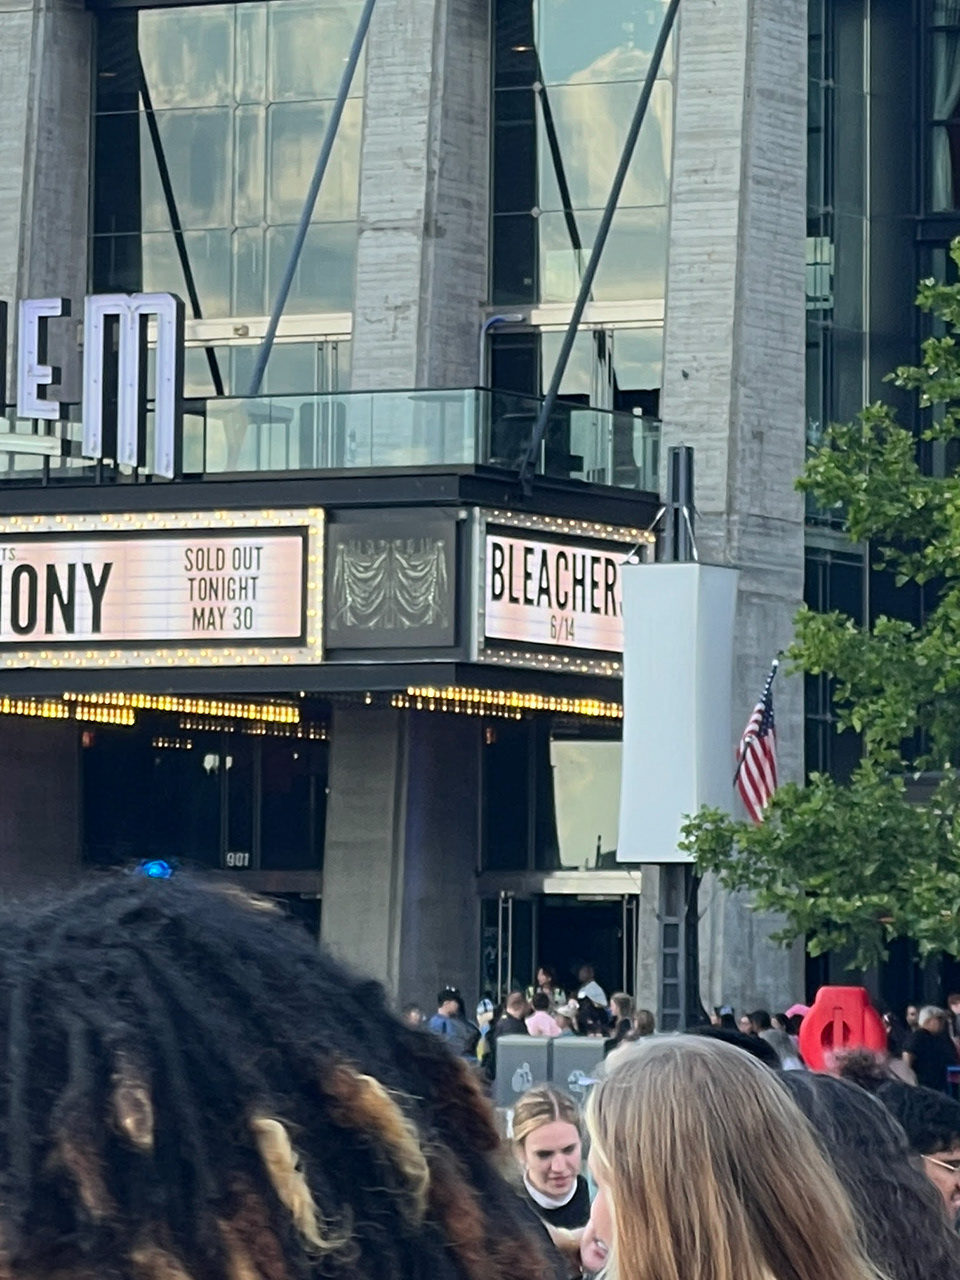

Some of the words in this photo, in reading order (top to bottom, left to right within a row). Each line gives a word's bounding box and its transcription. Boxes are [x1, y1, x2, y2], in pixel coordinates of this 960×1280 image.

[184, 547, 225, 571] SOLD
[232, 546, 263, 570] OUT
[187, 576, 259, 601] TONIGHT
[491, 542, 623, 617] BLEACHER
[192, 607, 226, 631] MAY
[233, 606, 253, 630] 30
[550, 615, 575, 642] 6/14
[226, 852, 249, 867] 901
